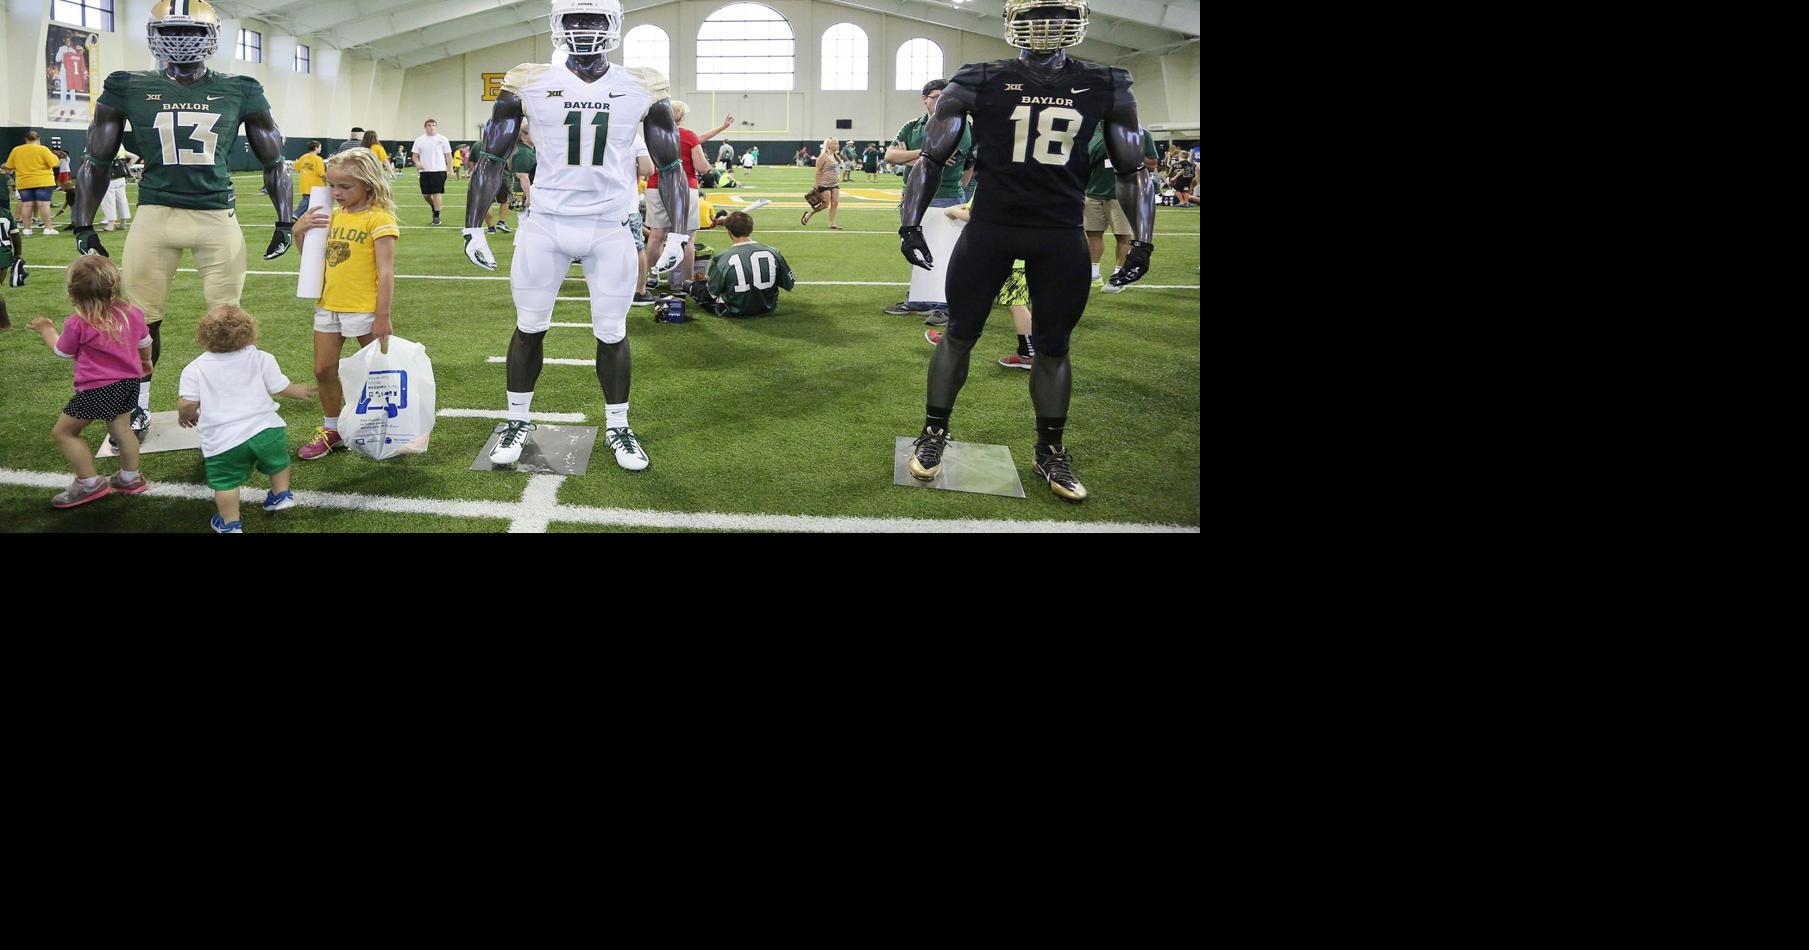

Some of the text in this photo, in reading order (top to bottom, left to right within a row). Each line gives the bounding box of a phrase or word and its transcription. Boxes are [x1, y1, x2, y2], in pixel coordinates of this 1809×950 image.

[162, 103, 210, 111] BAYLOR
[563, 101, 611, 110] BAYLOR
[1021, 95, 1073, 106] BAYLOR
[153, 111, 221, 166] 13
[563, 111, 611, 166] 11
[1009, 105, 1084, 166] 18
[728, 250, 777, 293] 10
